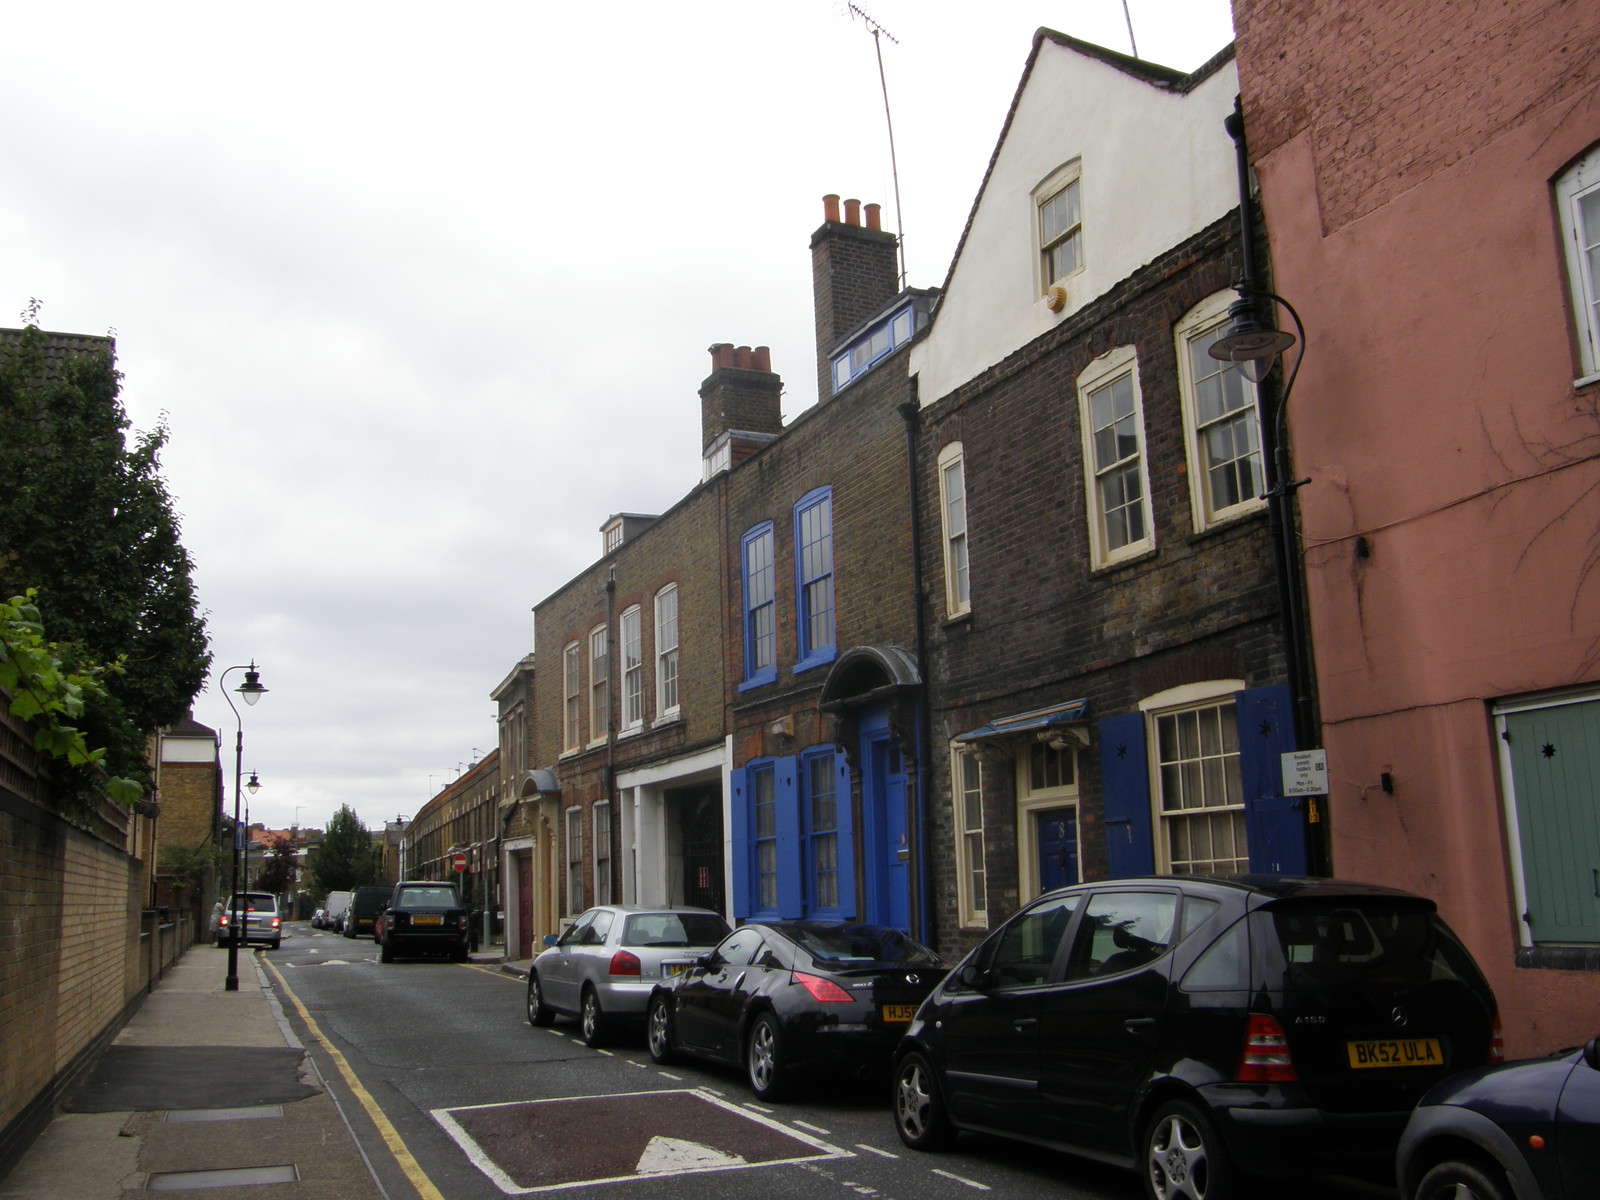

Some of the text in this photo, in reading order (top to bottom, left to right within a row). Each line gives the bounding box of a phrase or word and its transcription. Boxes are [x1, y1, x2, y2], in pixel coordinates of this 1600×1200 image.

[1059, 822, 1065, 838] 8
[1356, 1041, 1436, 1063] BK52 ULA
